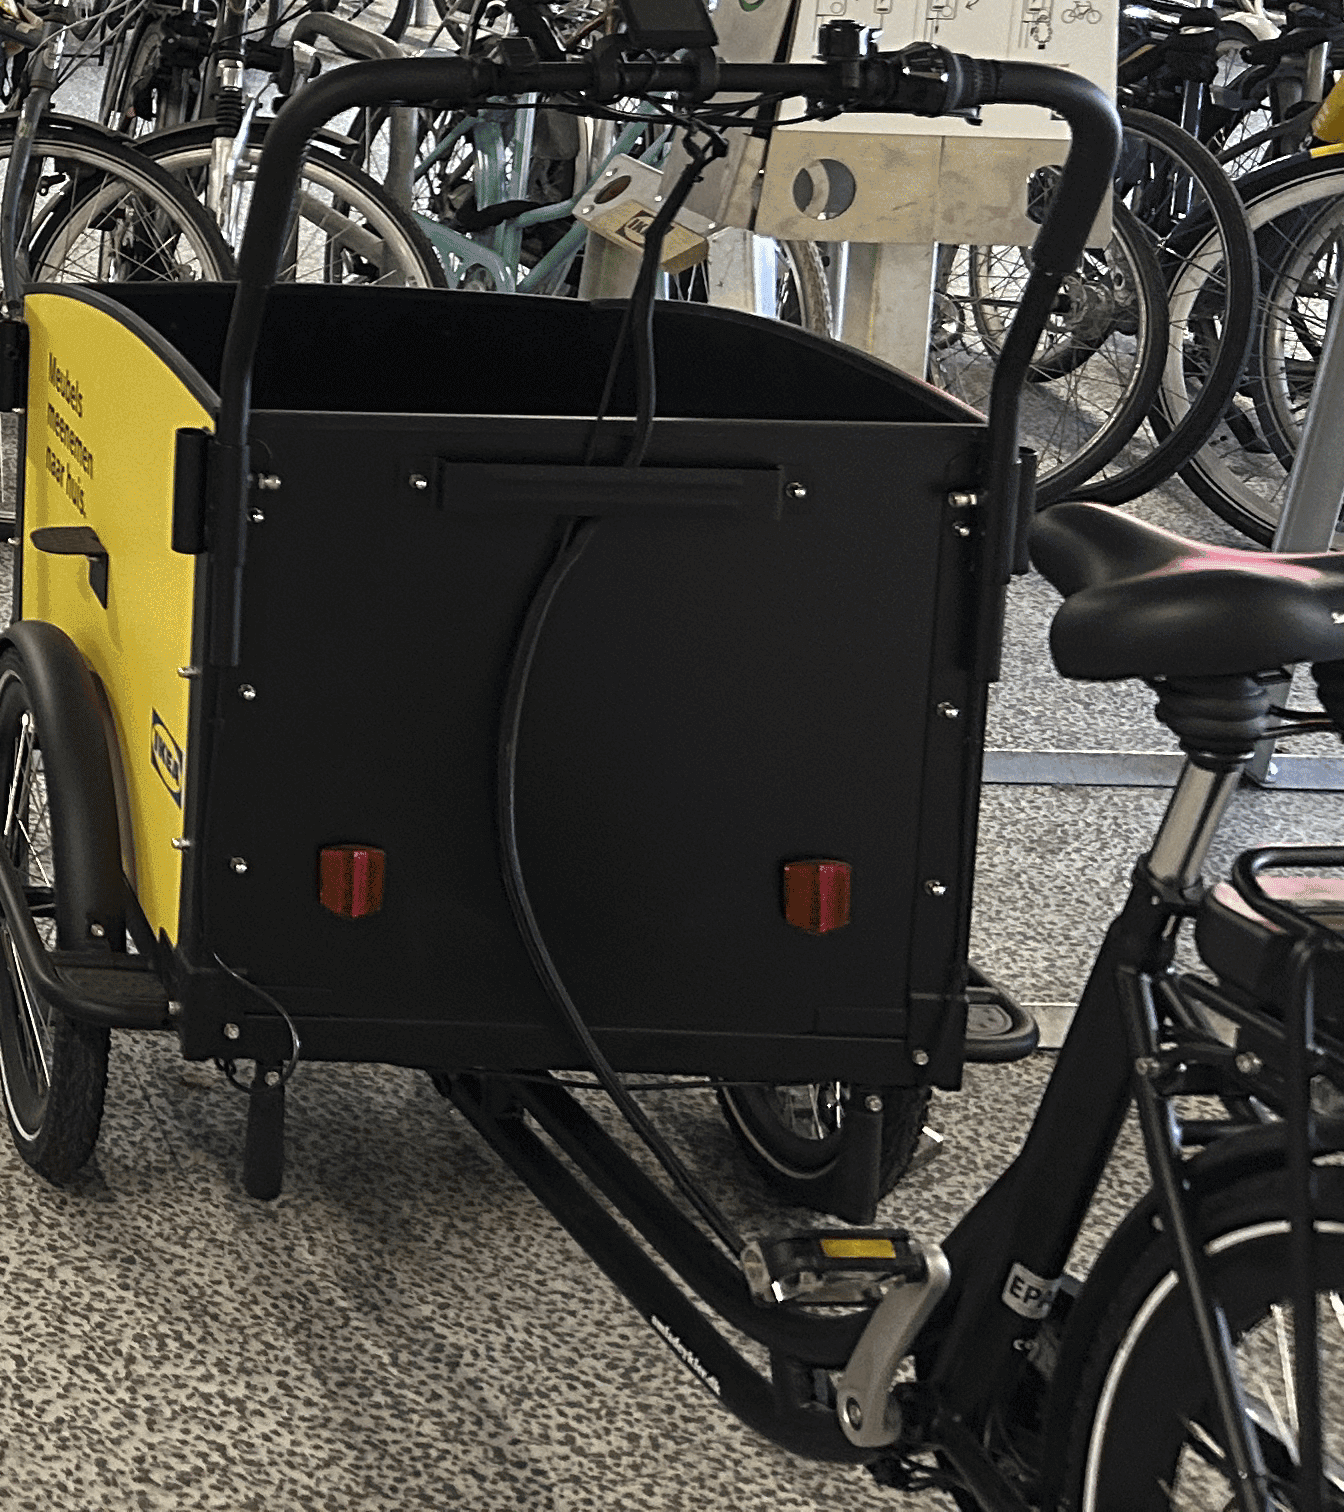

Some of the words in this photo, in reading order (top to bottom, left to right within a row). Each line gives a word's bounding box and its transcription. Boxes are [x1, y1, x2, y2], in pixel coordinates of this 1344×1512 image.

[49, 352, 83, 418] Meubels
[47, 402, 94, 480] meenemen
[46, 446, 65, 488] naar
[65, 462, 87, 519] huis.
[153, 729, 180, 787] IKEA
